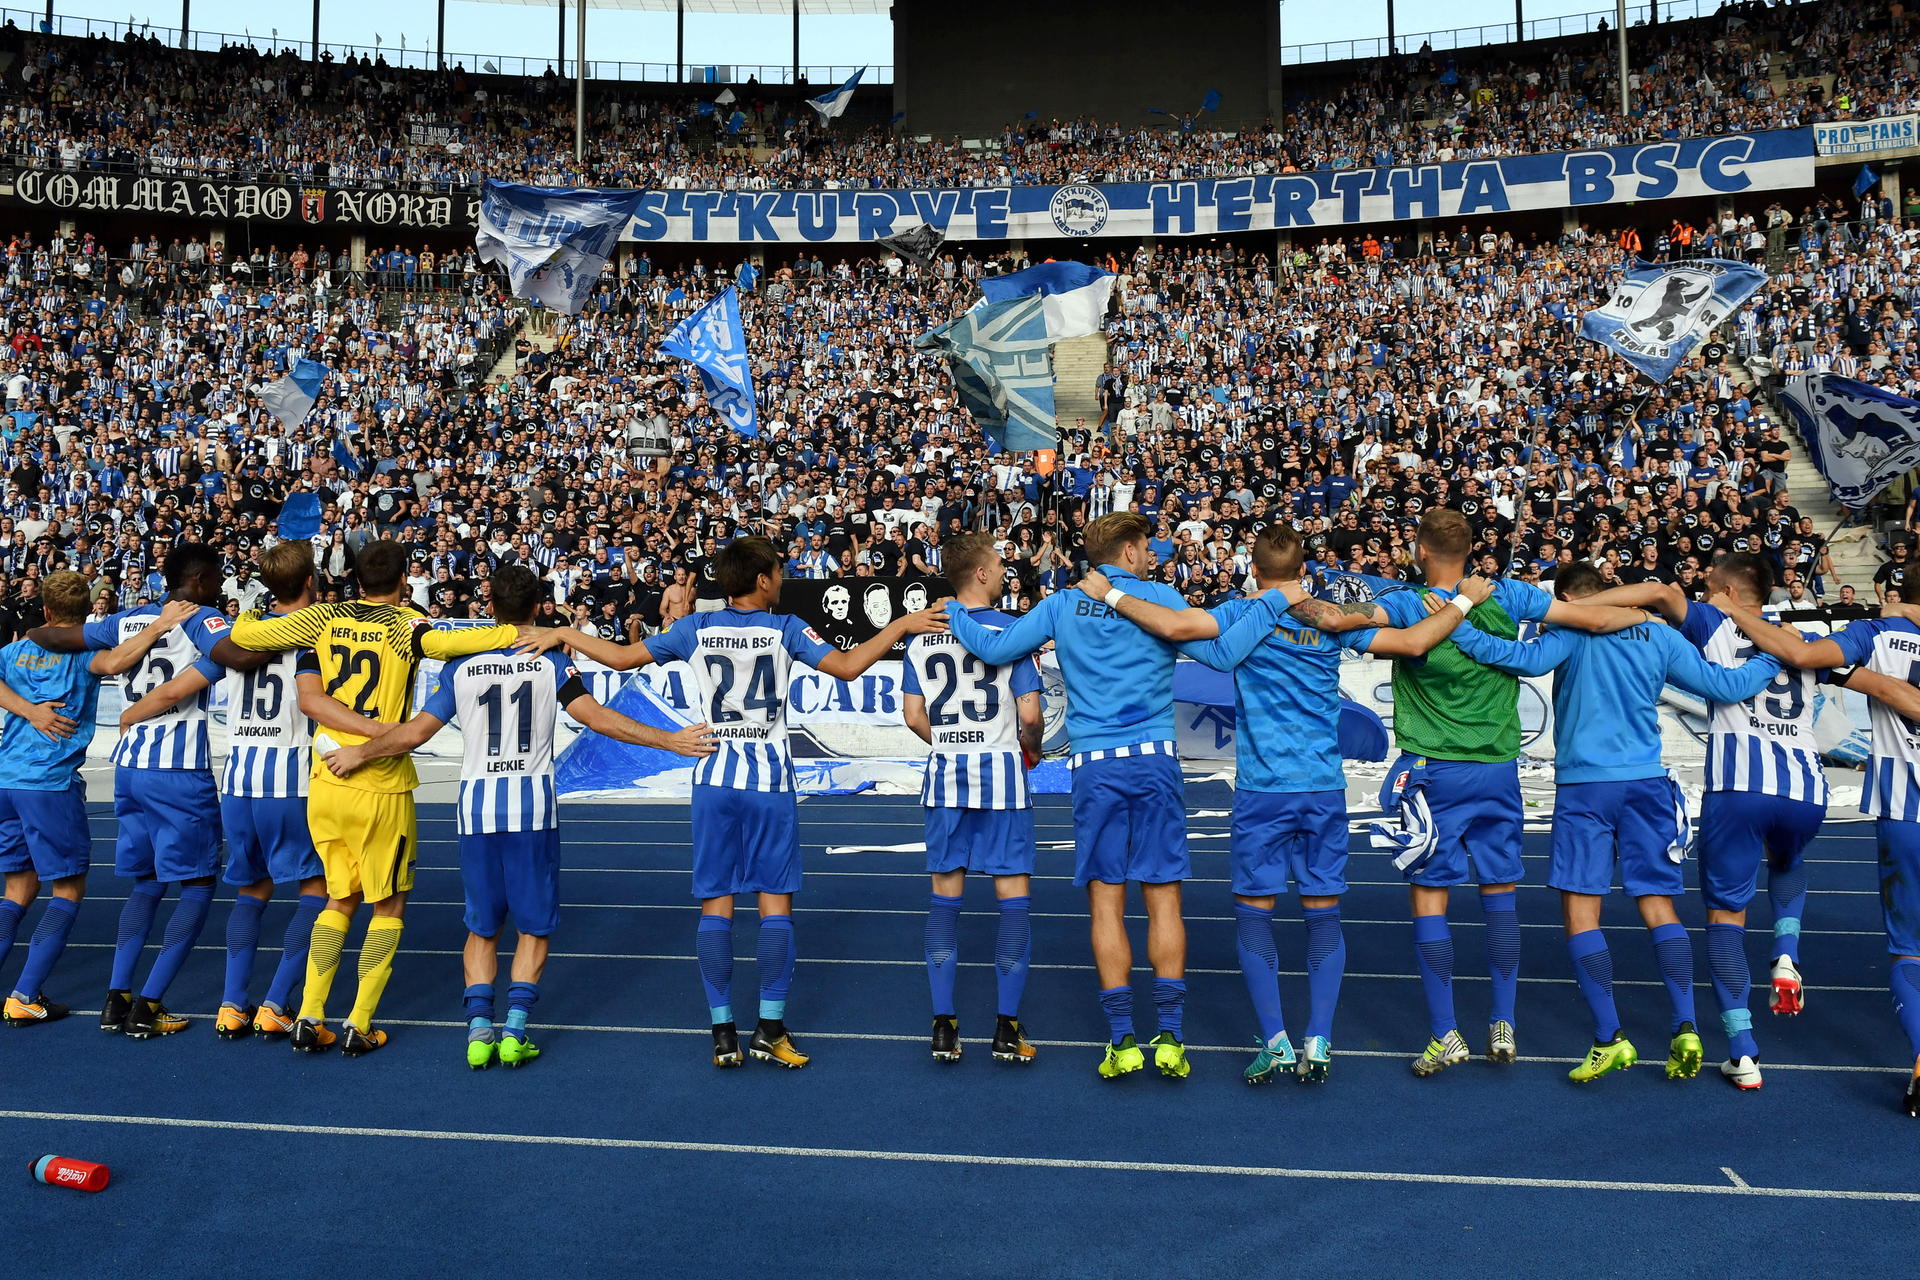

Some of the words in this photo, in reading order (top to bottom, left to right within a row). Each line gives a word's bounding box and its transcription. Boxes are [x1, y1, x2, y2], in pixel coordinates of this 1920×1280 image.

[1817, 127, 1850, 145] PRO
[1871, 120, 1912, 140] FANS
[630, 189, 1011, 242] STKURVE
[1149, 160, 1512, 236] HERTHA
[1562, 135, 1756, 207] BSC
[1056, 187, 1103, 205] OSTKURVE
[16, 169, 292, 220] COMMANDO
[335, 190, 452, 229] NORD
[1055, 216, 1088, 236] HERTHA
[1090, 216, 1104, 233] BSC
[360, 631, 383, 642] BSC
[702, 636, 748, 648] HERTHA
[752, 637, 775, 649] BSC
[467, 664, 514, 677] HERTHA
[517, 661, 542, 673] BSC
[326, 644, 380, 720] 22
[704, 654, 782, 724] 24
[925, 652, 1000, 726] 23
[478, 680, 533, 757] 11
[939, 730, 985, 744] WEISER
[487, 759, 525, 773] LECKIE
[1592, 1053, 1609, 1072] adidas
